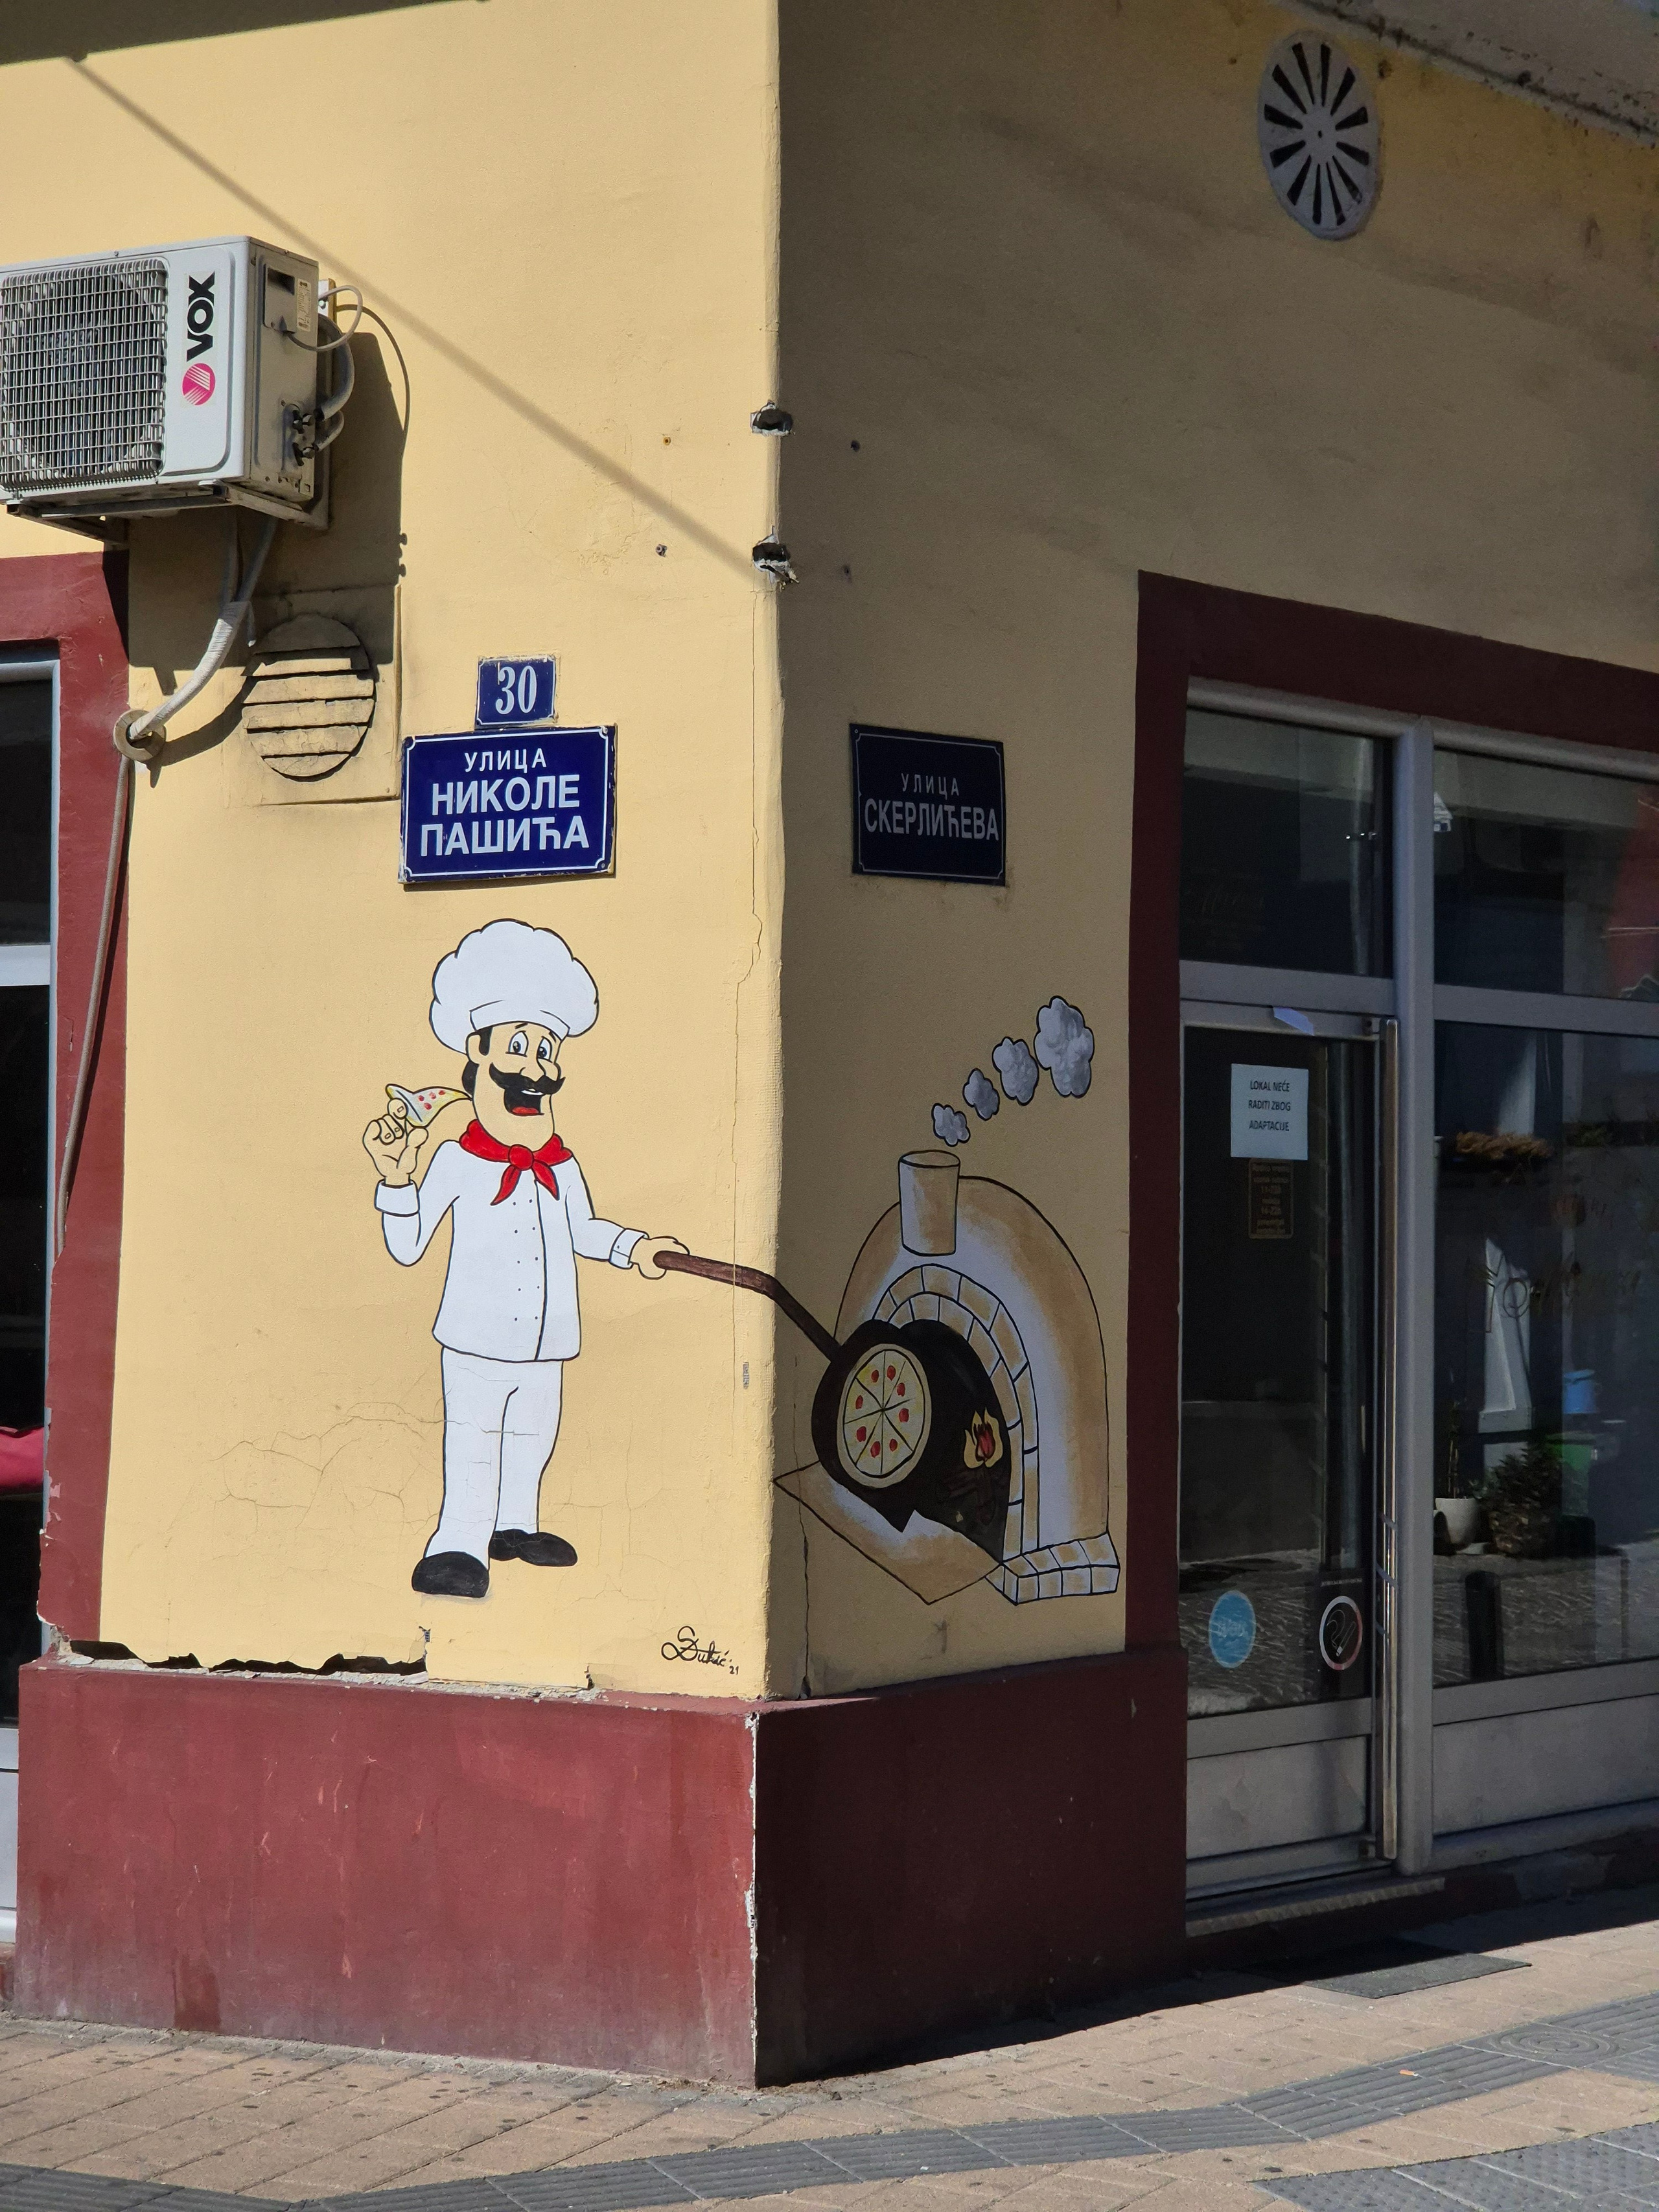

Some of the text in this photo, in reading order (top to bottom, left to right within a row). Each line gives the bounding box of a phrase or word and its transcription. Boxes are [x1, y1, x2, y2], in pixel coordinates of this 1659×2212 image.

[186, 271, 215, 362] VOX
[495, 665, 537, 715] 30
[464, 747, 547, 774] УЛИЦА
[432, 774, 581, 816] НИКОЛЕ
[901, 773, 960, 800] УЛИЦА
[421, 815, 590, 857] ПАШИЋА
[864, 798, 999, 841] СКЕРЛИЋЕВА
[1249, 1080, 1290, 1092] LOKAL NEĆE
[1248, 1099, 1291, 1111] RADITI ZBOG
[1249, 1120, 1290, 1132] ADAPTACIJE
